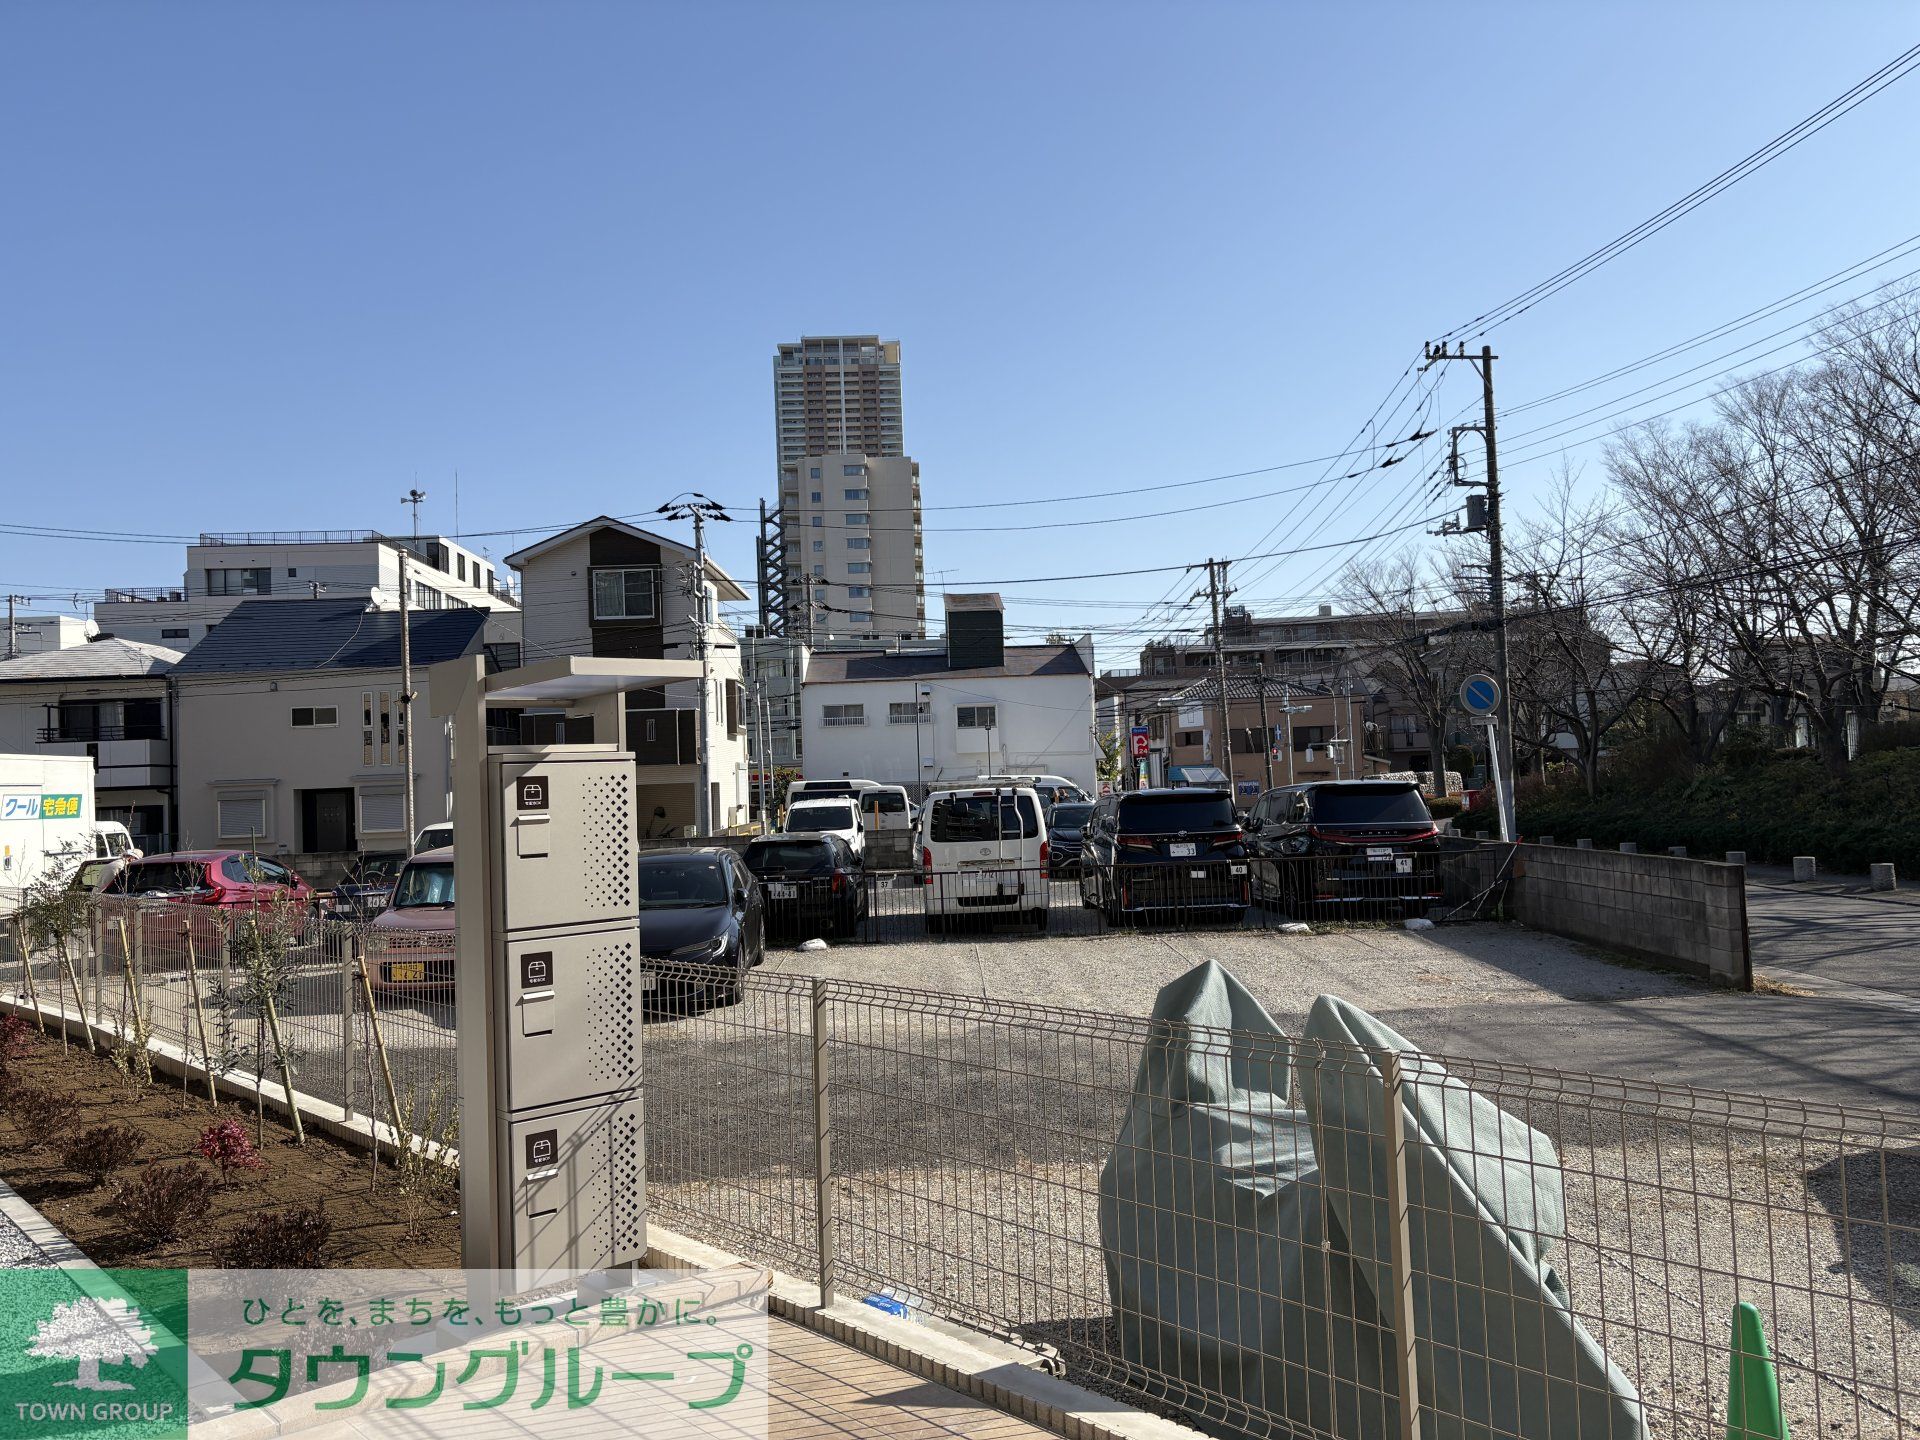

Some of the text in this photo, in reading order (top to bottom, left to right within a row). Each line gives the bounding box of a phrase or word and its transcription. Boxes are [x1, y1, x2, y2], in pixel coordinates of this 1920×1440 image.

[5, 797, 79, 817] クール 宅急便
